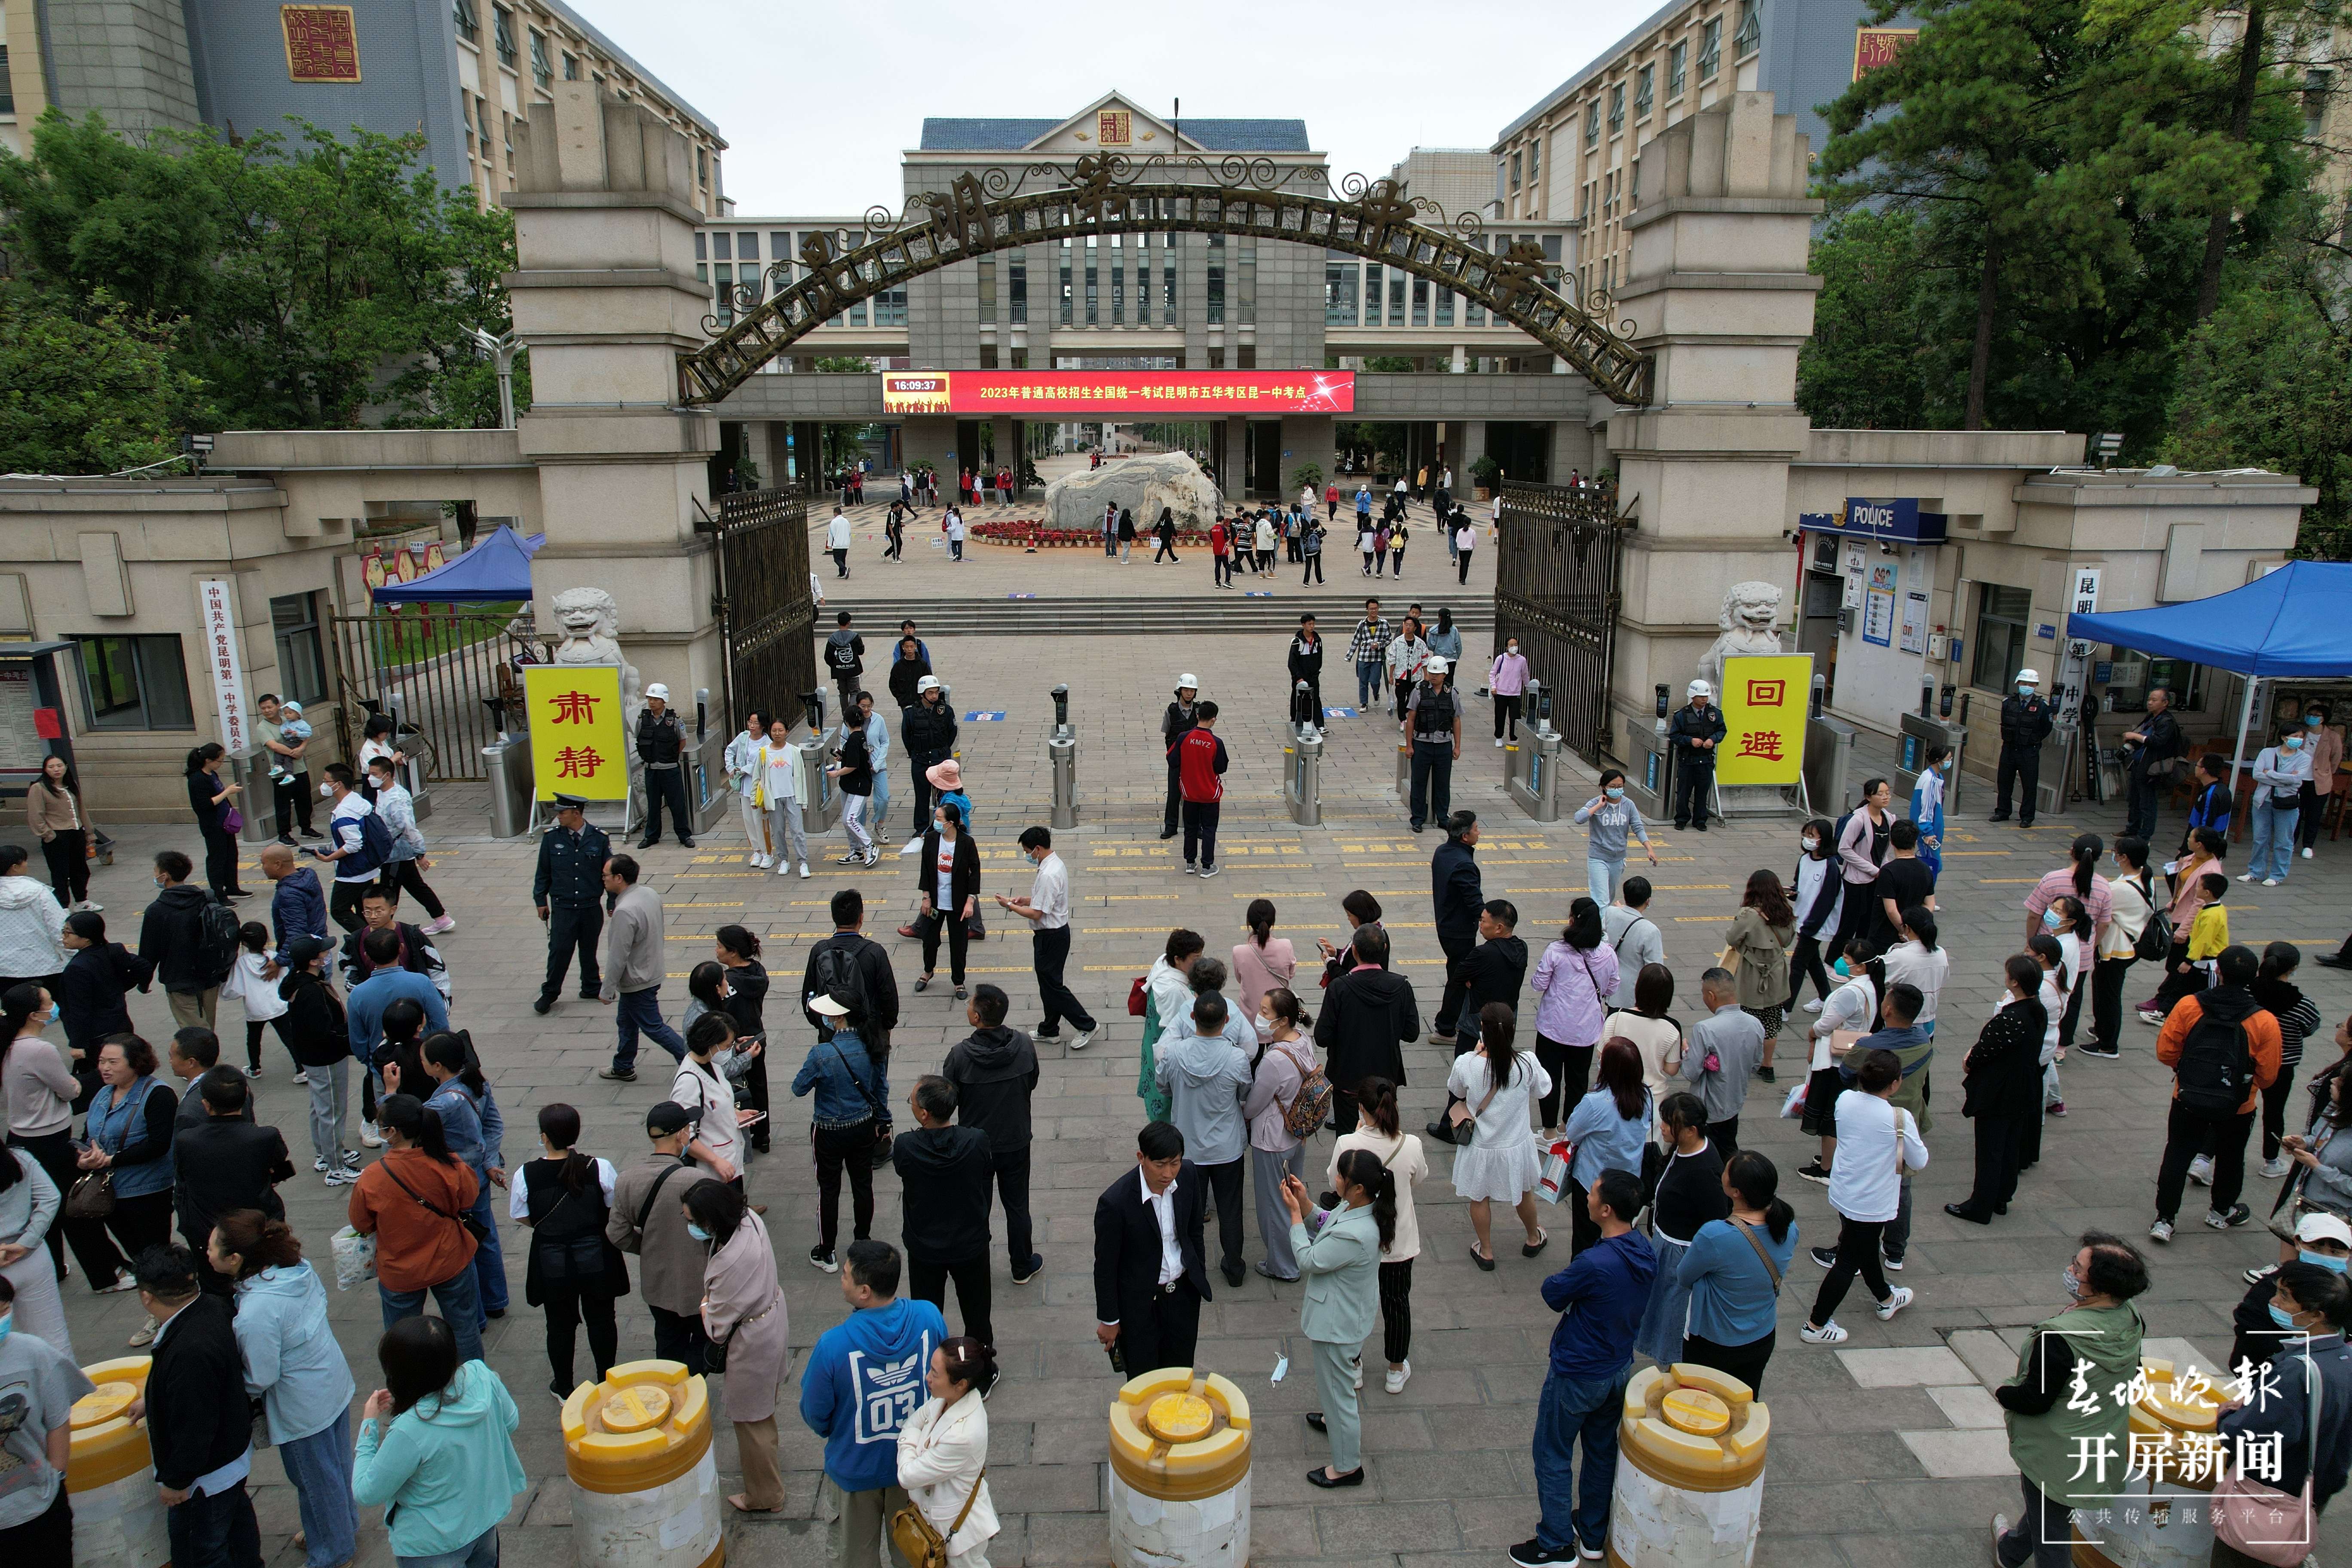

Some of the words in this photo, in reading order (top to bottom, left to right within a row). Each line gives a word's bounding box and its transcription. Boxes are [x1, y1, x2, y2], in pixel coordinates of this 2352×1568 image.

[894, 381, 936, 390] 16:09:37
[980, 386, 1306, 399] 2023年普通高校招生全国统一考试昆明市五华考区昆一中考点
[1854, 506, 1894, 527] POLICE
[208, 587, 242, 749] 中国共产党昆明第一中学委员会
[1735, 679, 1786, 762] 回避
[548, 690, 606, 778] 肃静
[1190, 738, 1211, 749] KMYZ
[1602, 813, 1627, 826] GAP
[870, 1390, 916, 1433] 03
